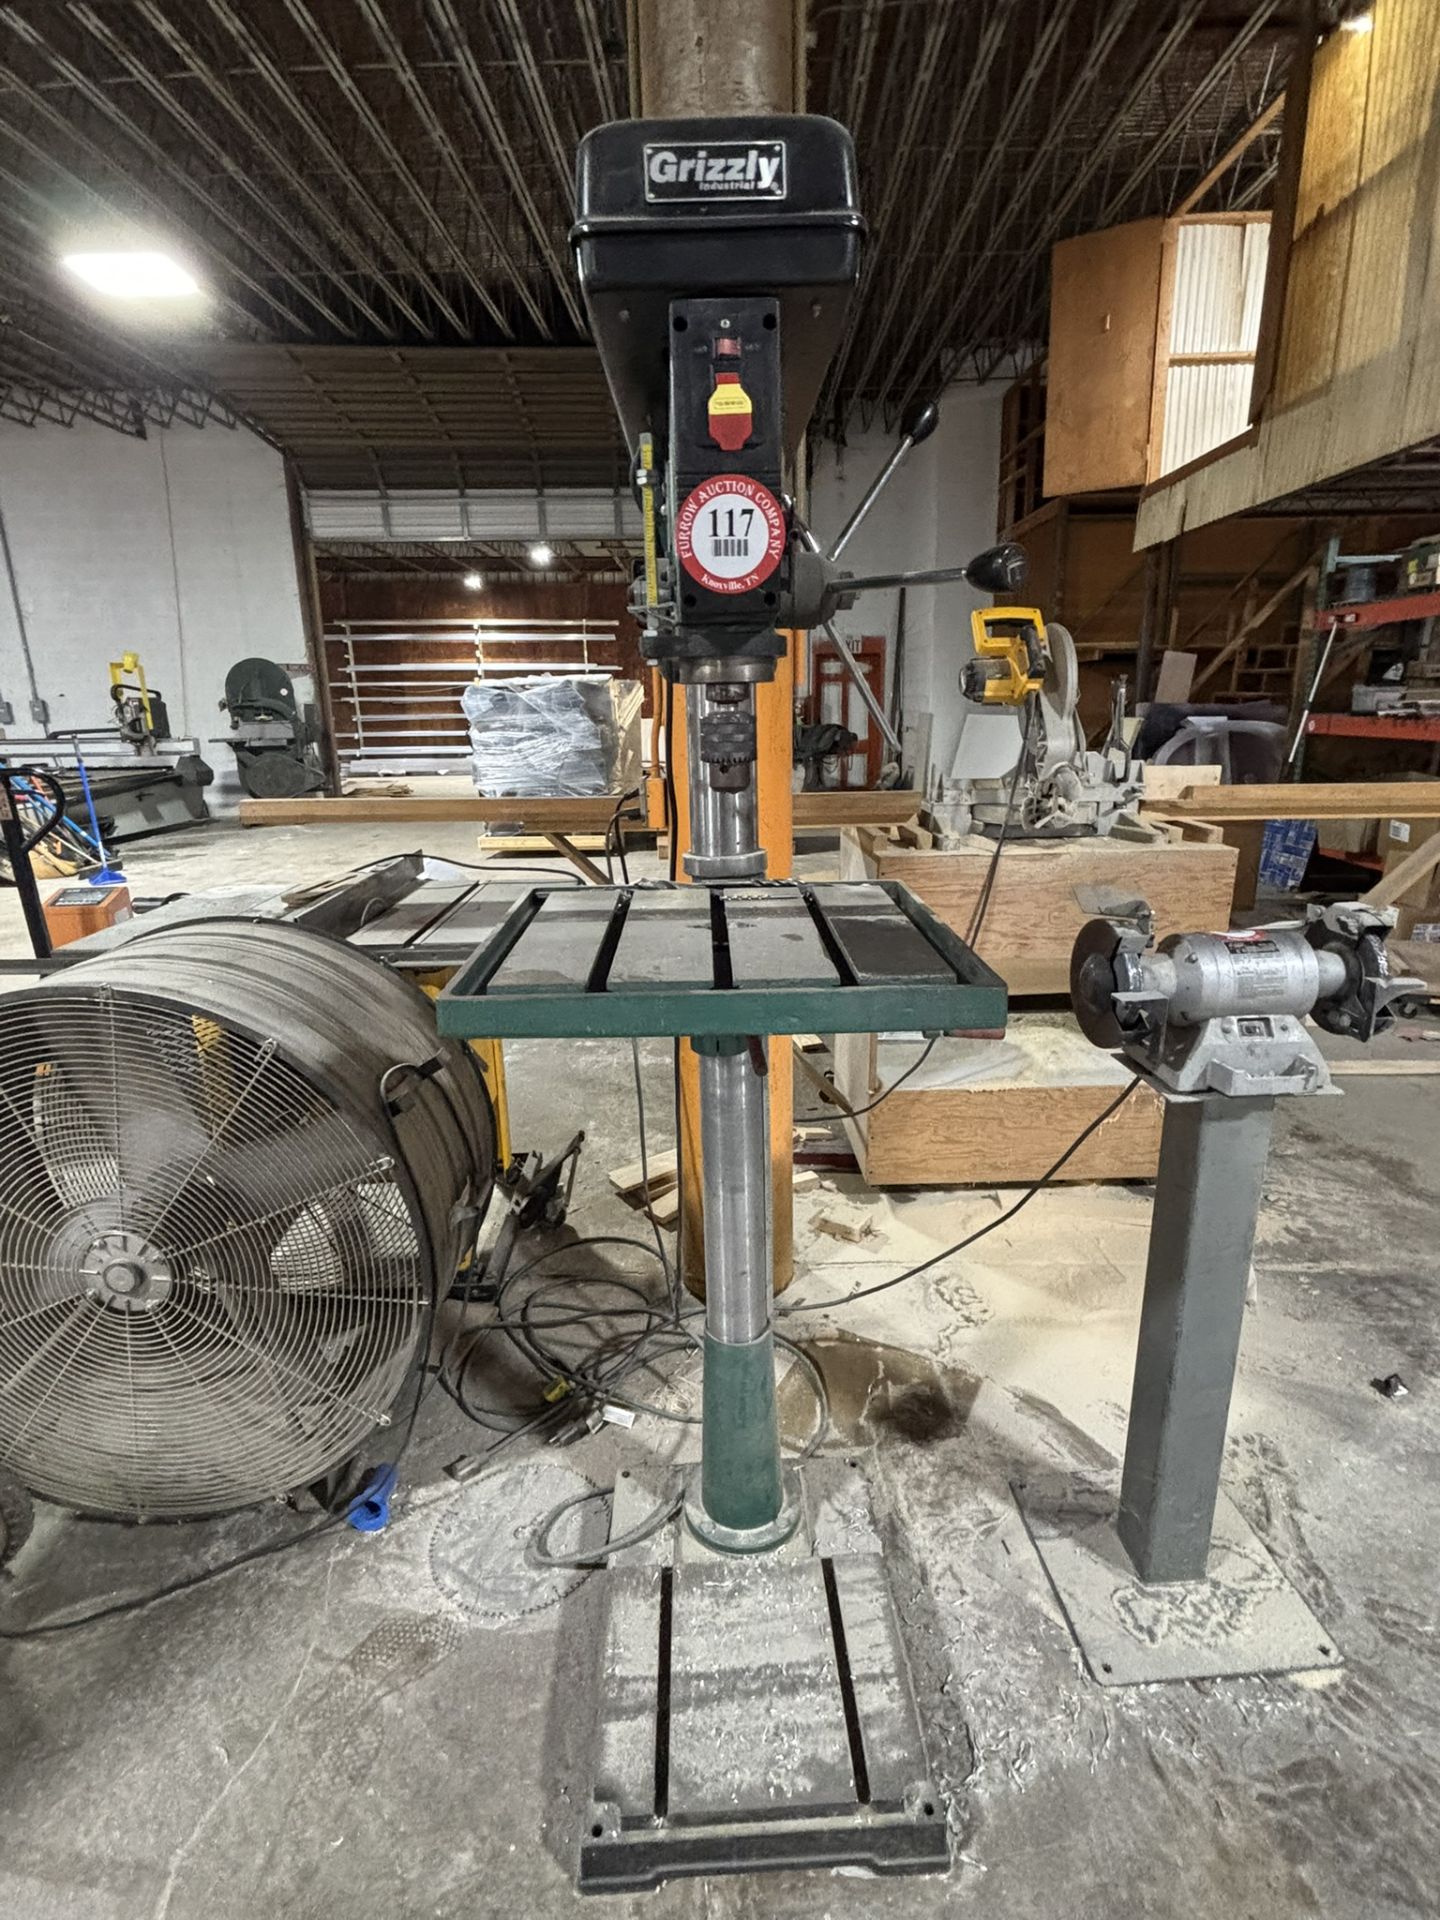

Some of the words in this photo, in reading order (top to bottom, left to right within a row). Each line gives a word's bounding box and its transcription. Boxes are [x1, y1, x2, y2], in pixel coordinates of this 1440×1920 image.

[649, 150, 780, 189] Grizzly
[679, 498, 699, 559] FURROW
[698, 481, 755, 503] AUCTION
[755, 492, 782, 560] COMPANY
[709, 508, 755, 538] 117
[743, 572, 760, 586] TN
